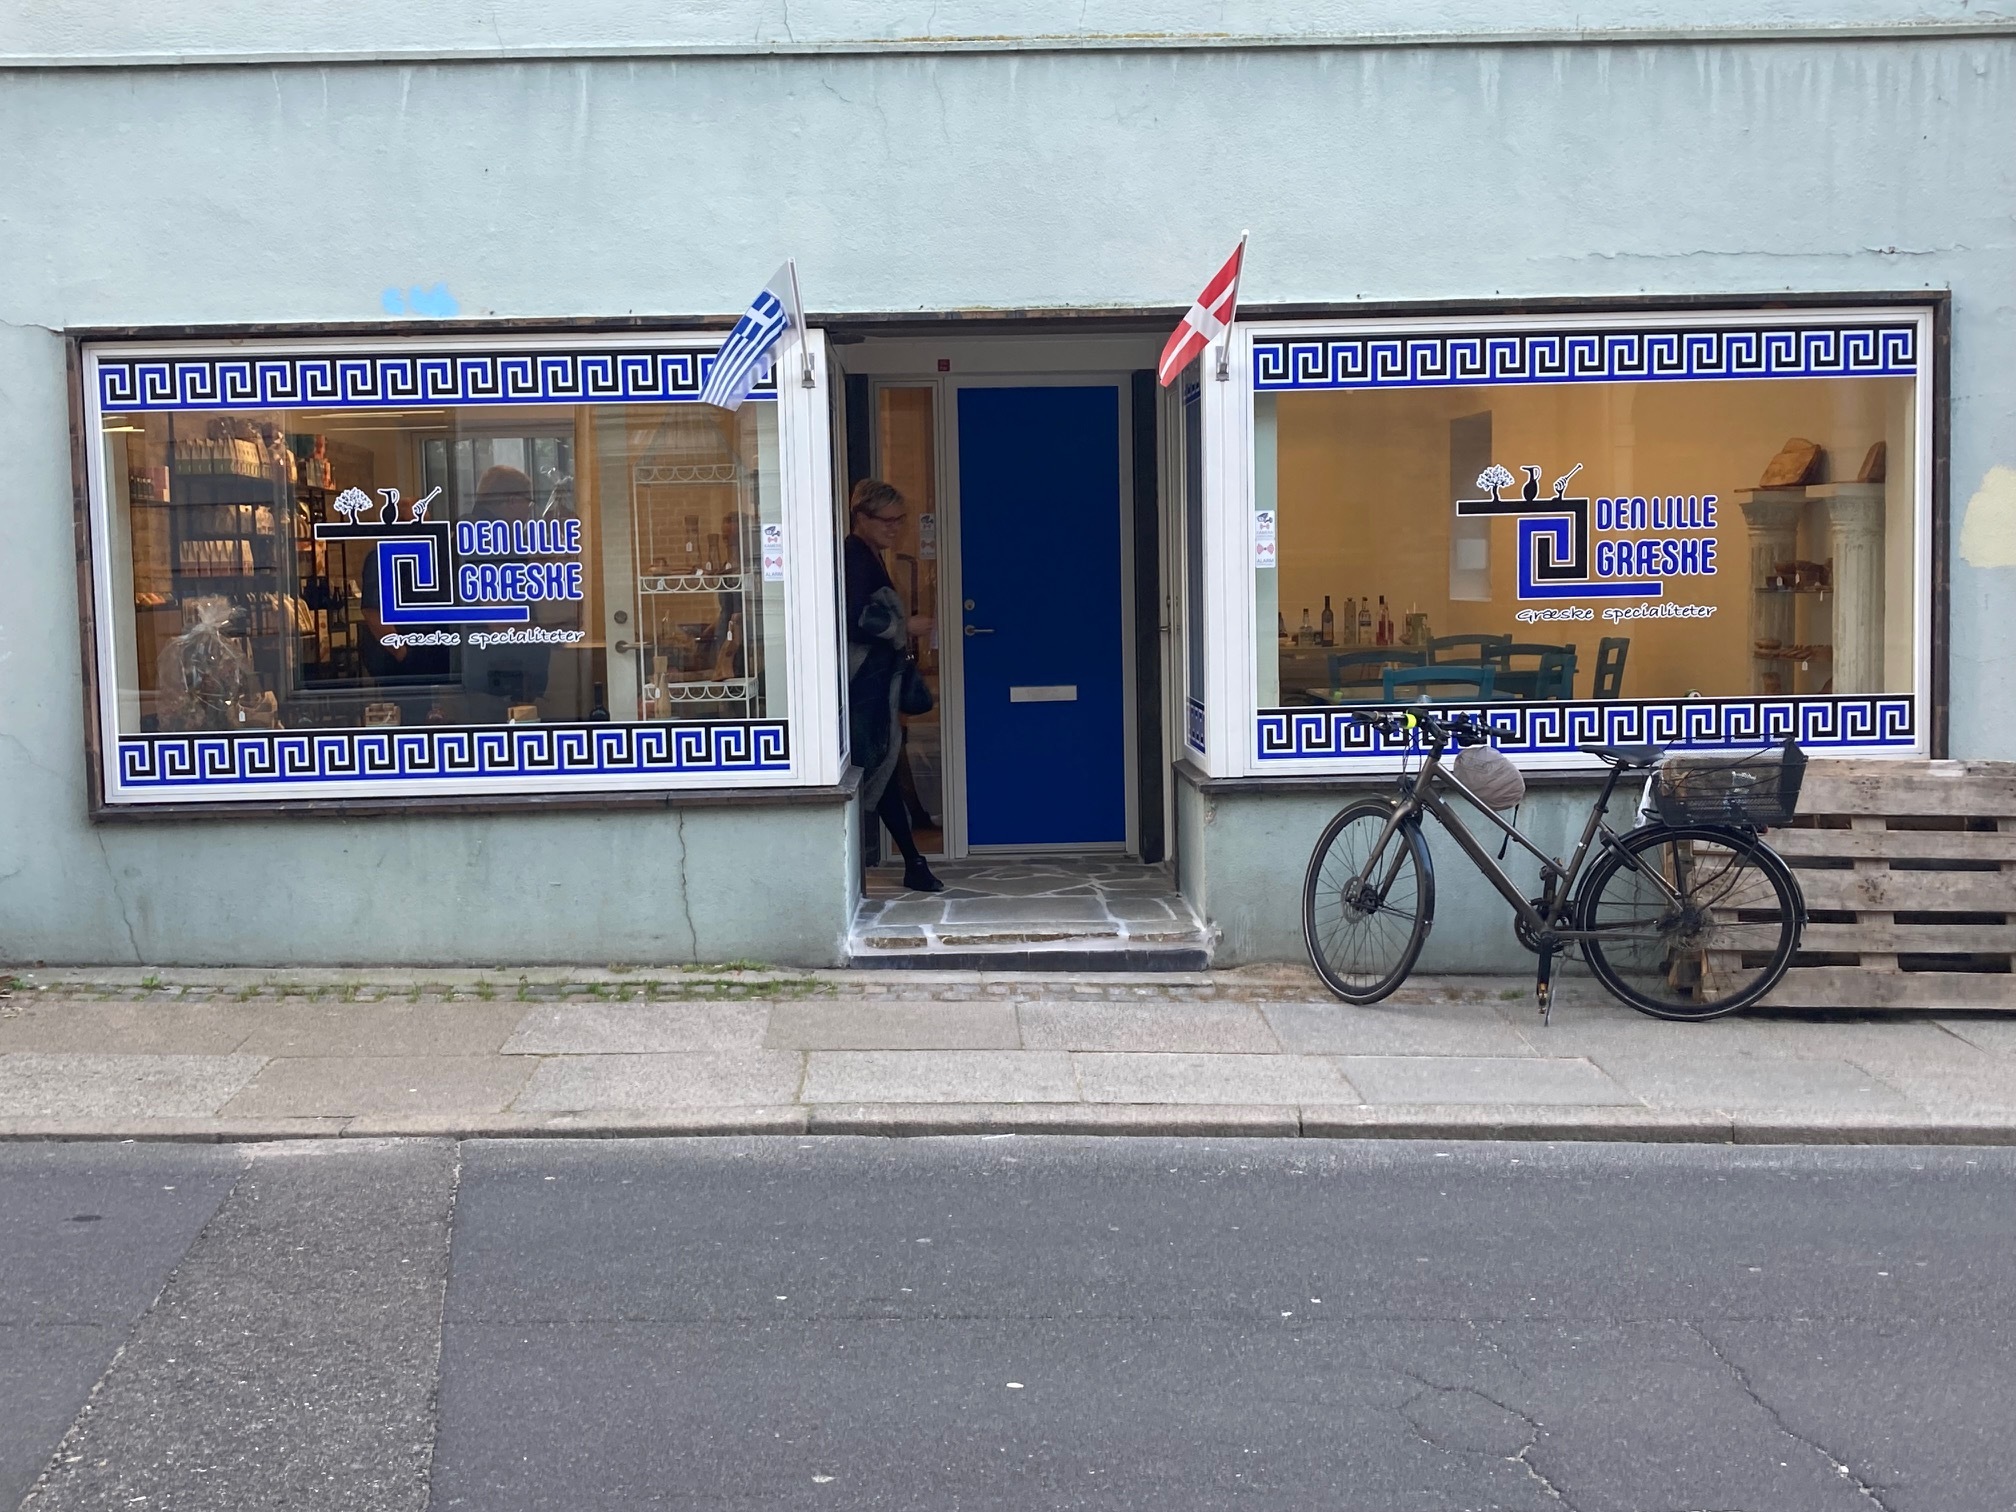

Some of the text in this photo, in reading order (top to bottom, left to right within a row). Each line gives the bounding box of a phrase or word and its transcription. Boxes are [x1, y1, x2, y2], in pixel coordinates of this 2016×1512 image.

[1596, 495, 1718, 531] DEN LILLE
[457, 519, 582, 554] DEN LILLE
[1596, 538, 1718, 577] GRÆSKE
[459, 563, 584, 602] GRÆSKE
[1602, 602, 1717, 624] specialiteter
[468, 627, 586, 650] specialiteter
